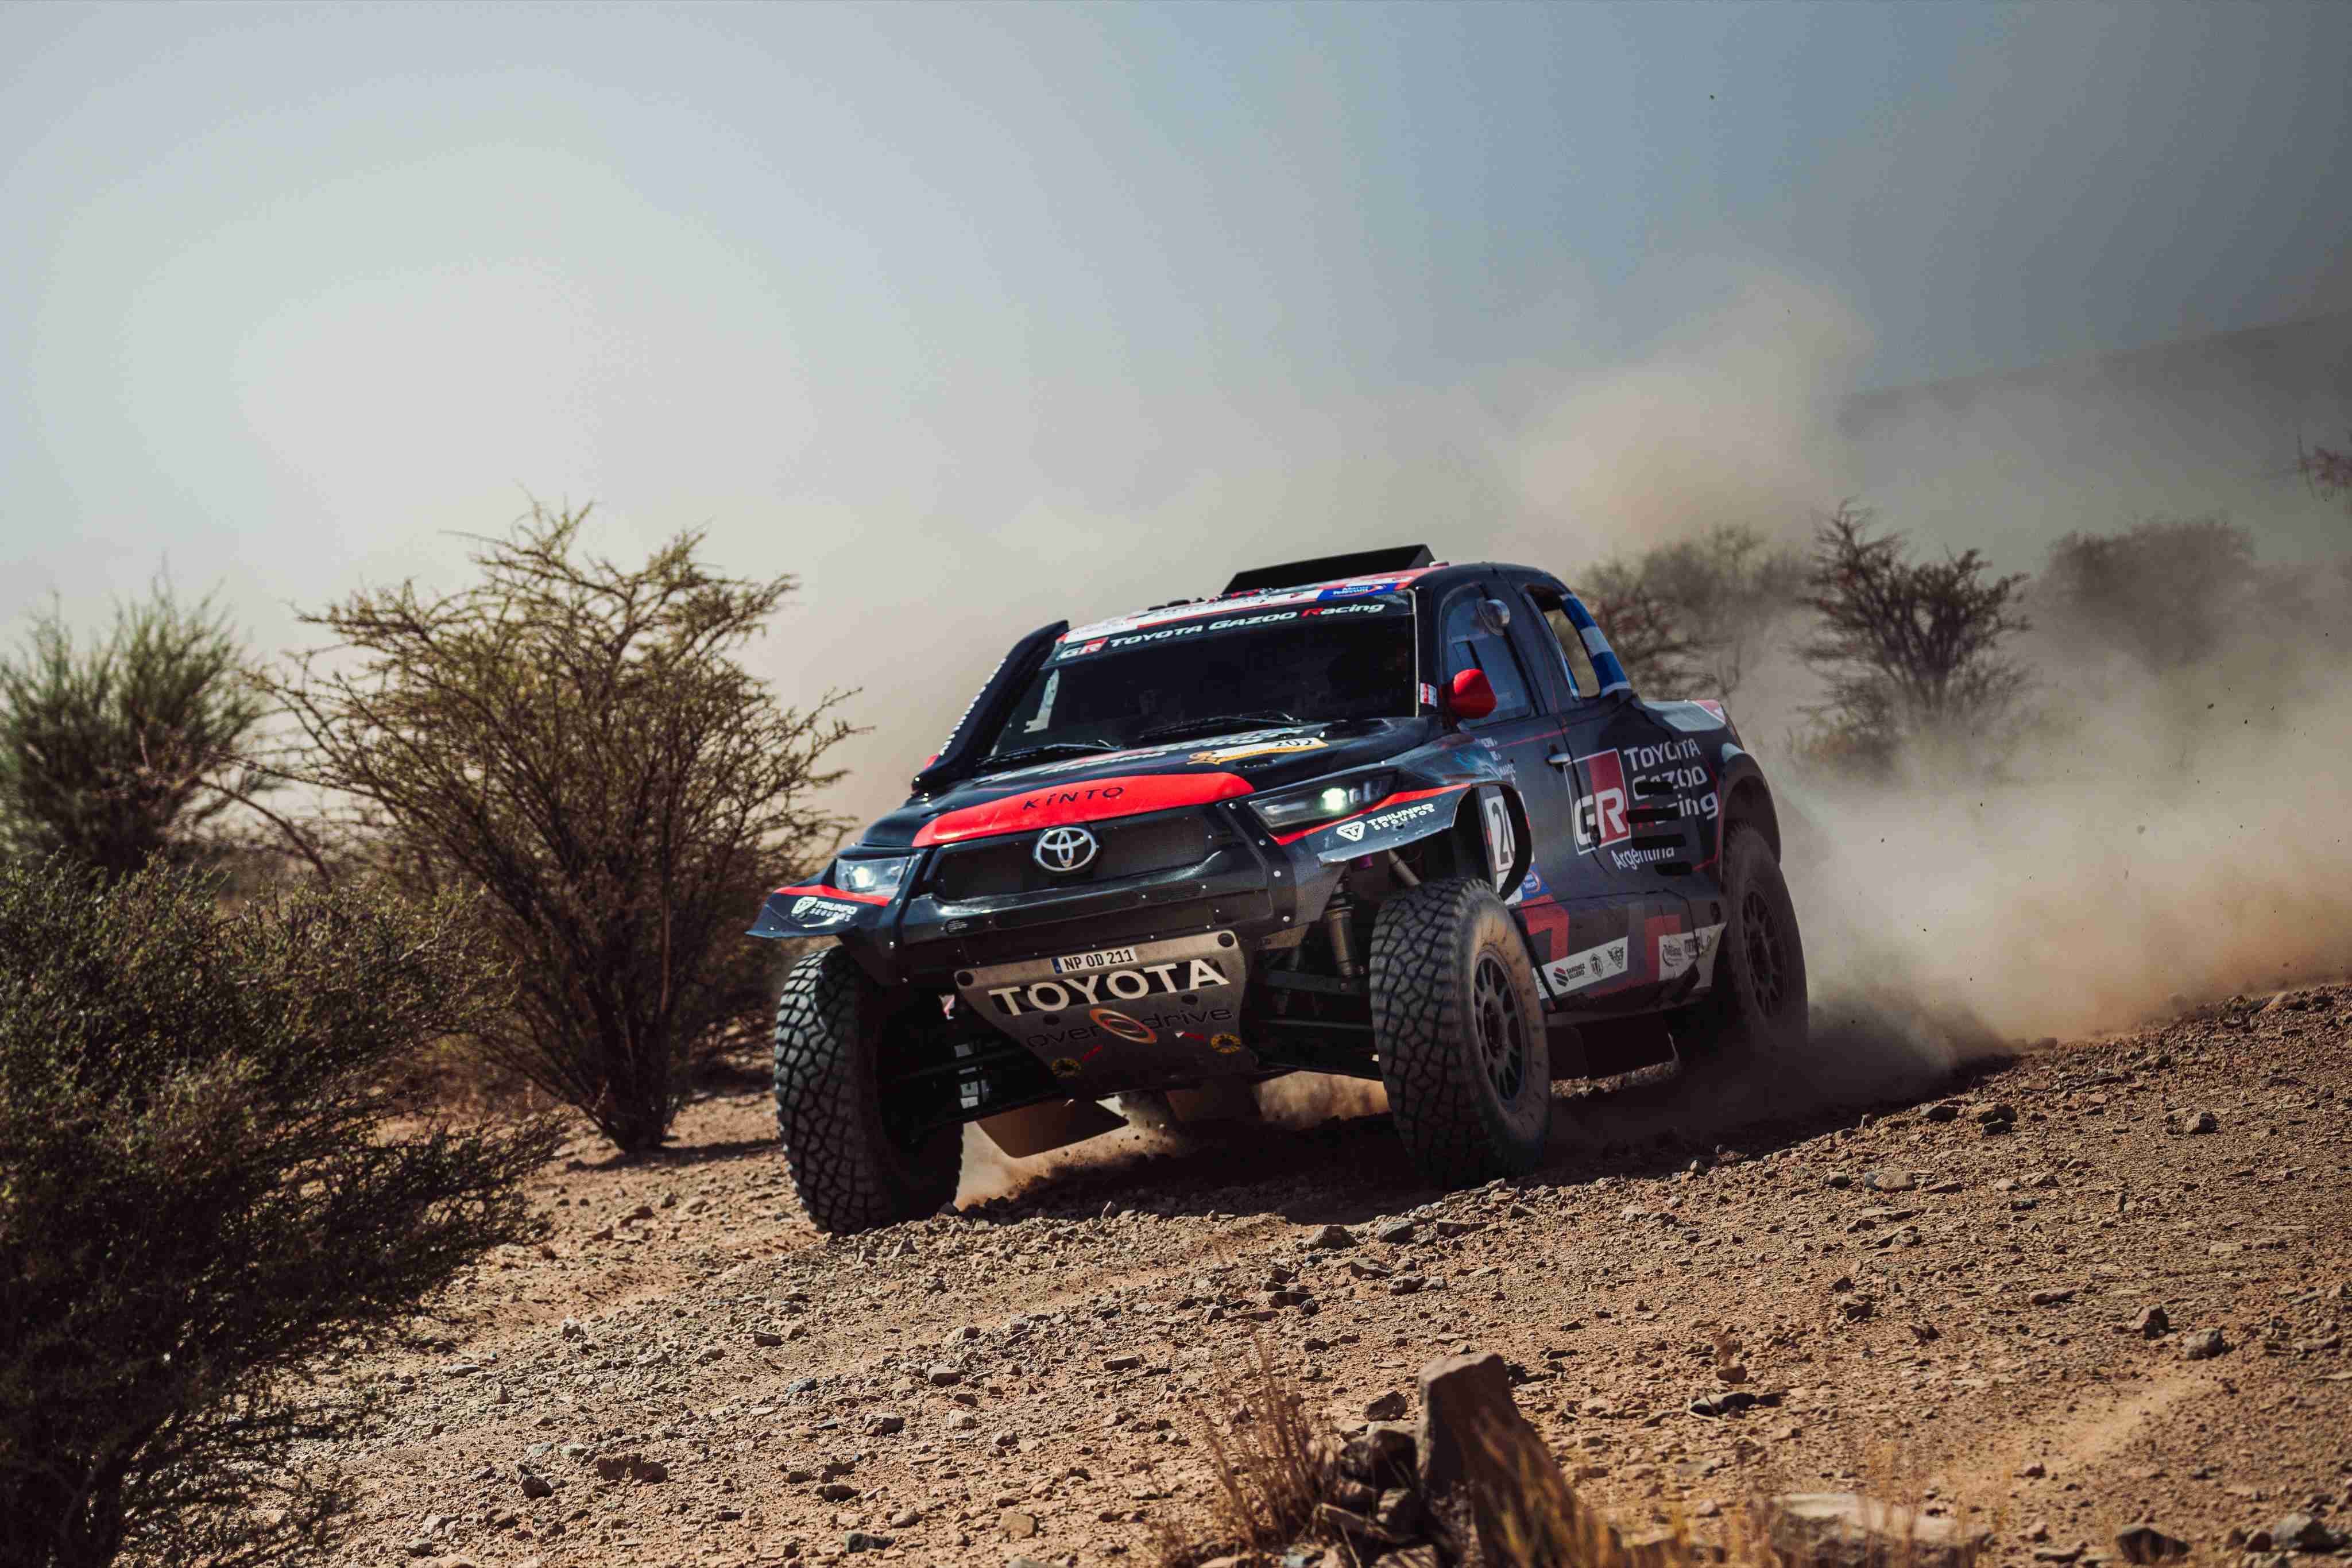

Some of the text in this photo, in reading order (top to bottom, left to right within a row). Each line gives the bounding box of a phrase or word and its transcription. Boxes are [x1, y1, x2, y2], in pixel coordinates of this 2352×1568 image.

[1056, 603, 1386, 660] GR TOYOTA GAZOO Racing
[1624, 737, 1701, 772] TOYOTA
[1366, 803, 1434, 827] TRIUNFO
[1573, 787, 1627, 846] GR
[1063, 957, 1082, 970] NP
[1085, 953, 1105, 967] OD
[1106, 948, 1134, 964] 211
[988, 958, 1231, 1017] TOYOTA
